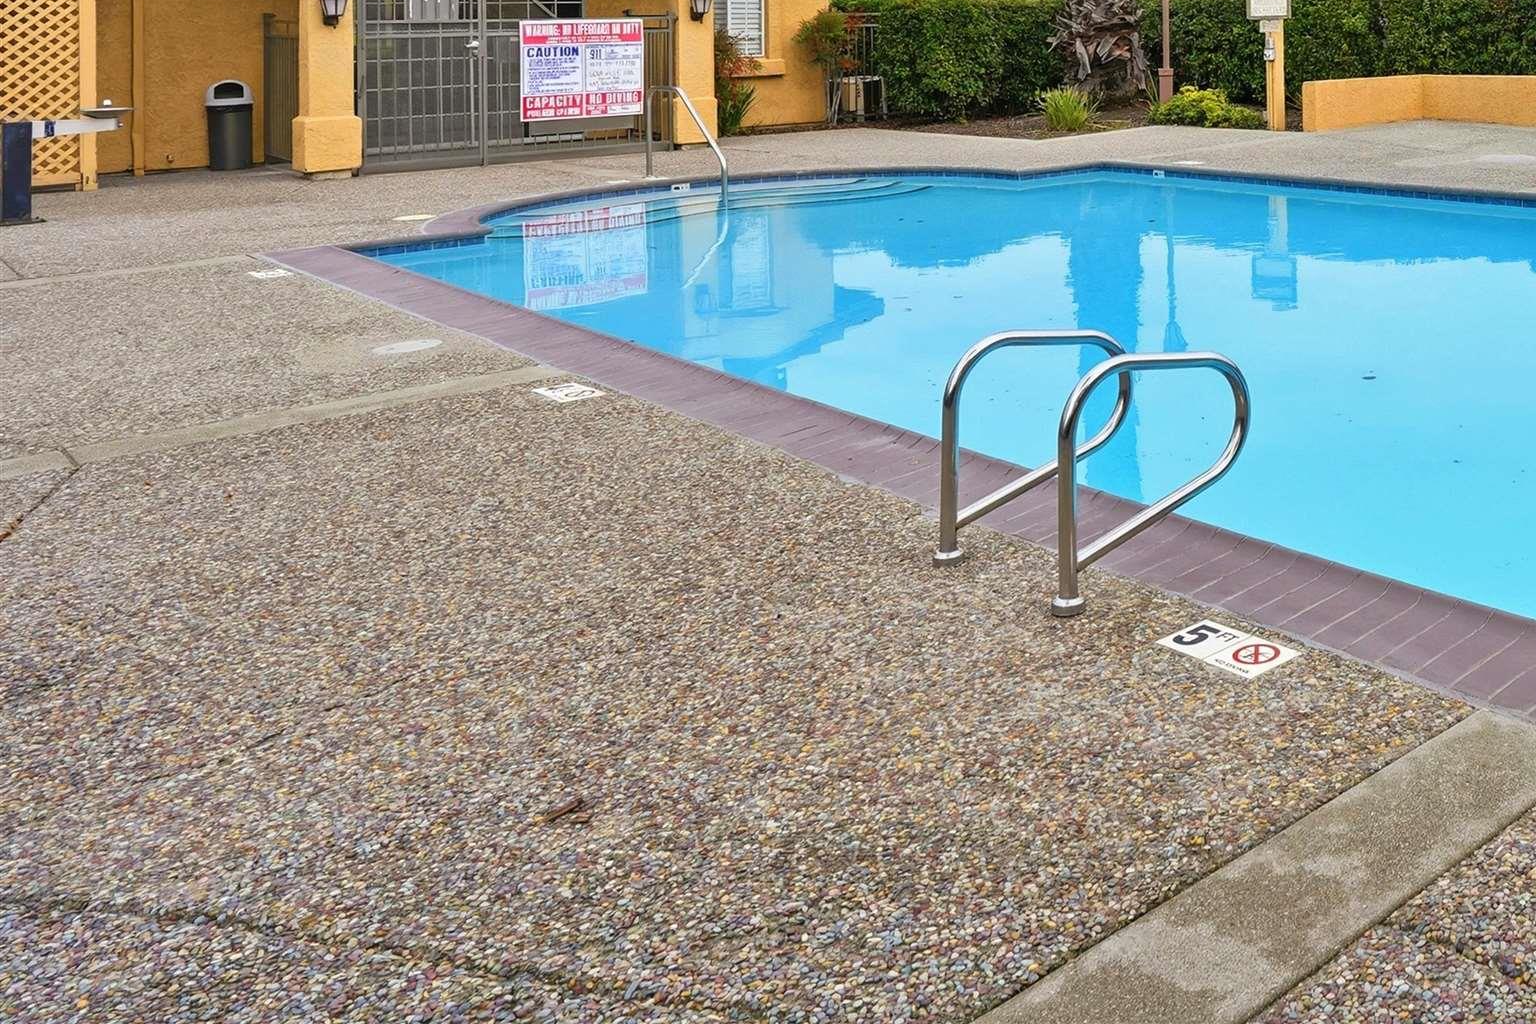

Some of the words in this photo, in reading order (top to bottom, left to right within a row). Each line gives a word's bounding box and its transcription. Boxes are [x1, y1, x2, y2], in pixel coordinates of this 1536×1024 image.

[527, 46, 579, 57] CAUTION
[590, 48, 602, 59] 911
[526, 94, 582, 109] CAPACITY
[590, 93, 602, 105] NO
[607, 91, 639, 104] DIVING
[1172, 624, 1222, 646] 5
[1215, 631, 1241, 643] FT
